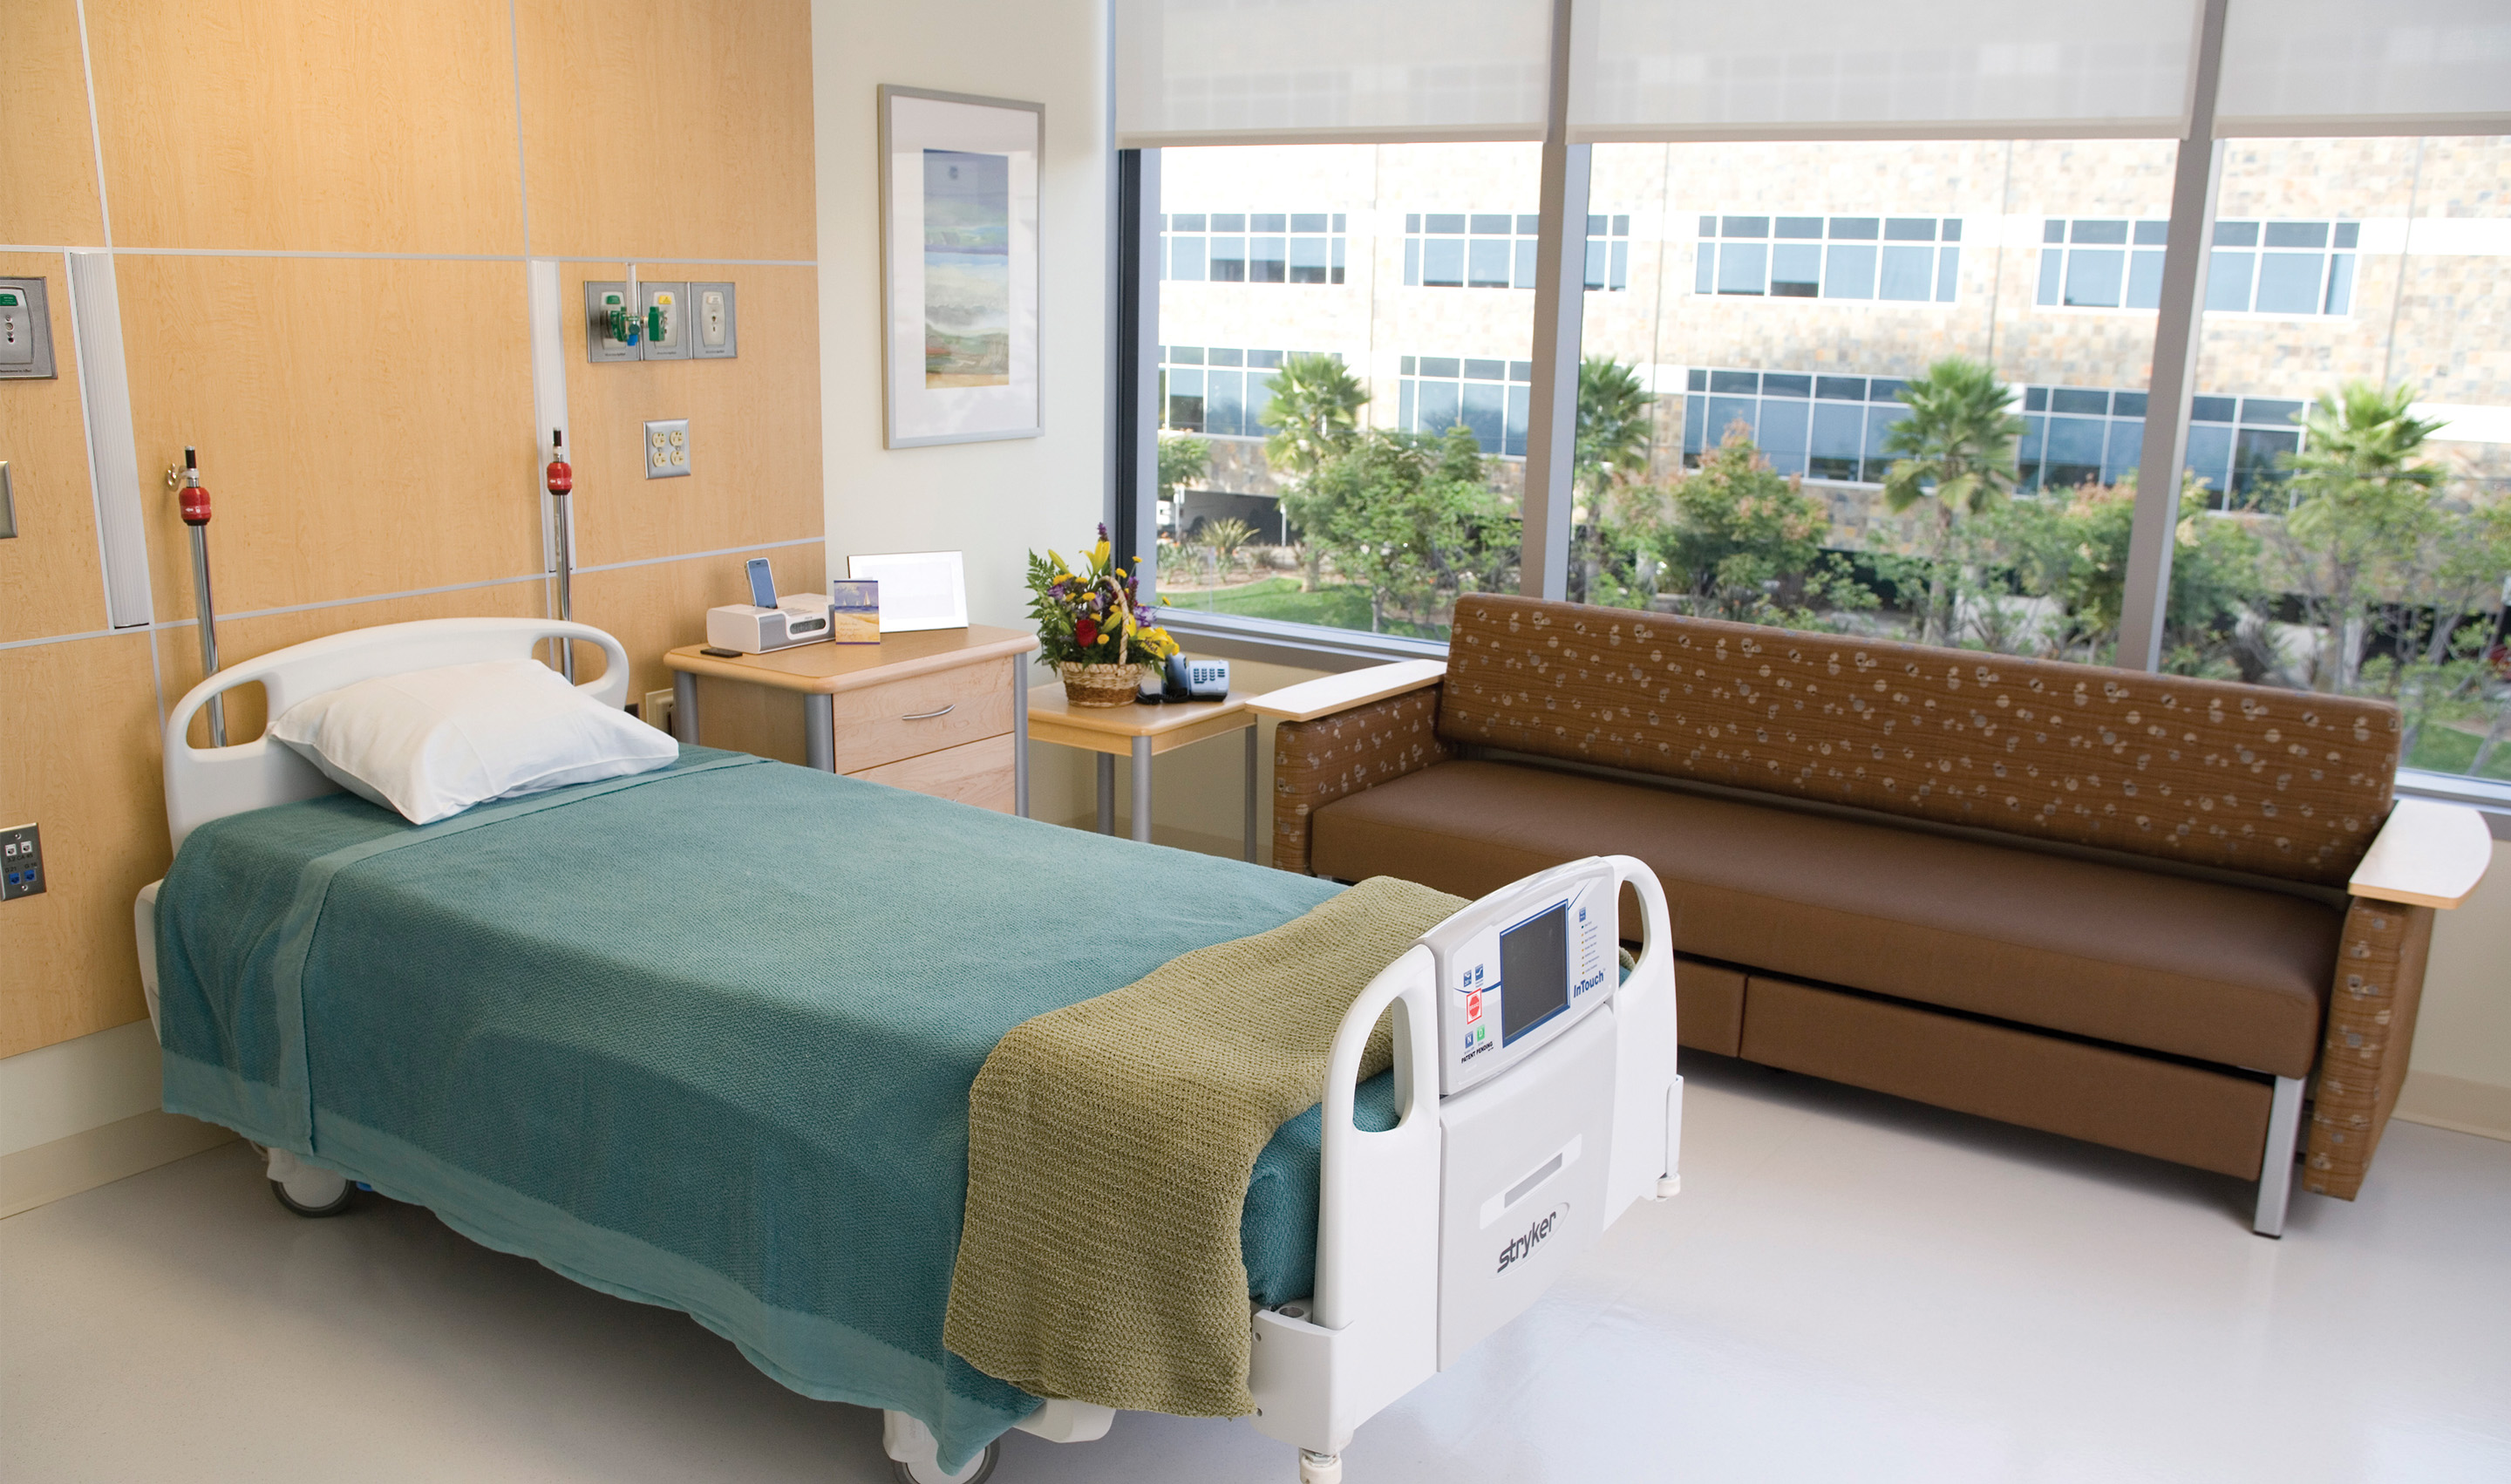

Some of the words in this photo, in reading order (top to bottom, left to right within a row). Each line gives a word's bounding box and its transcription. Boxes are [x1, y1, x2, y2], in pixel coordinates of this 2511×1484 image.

[1574, 971, 1604, 998] InTouch
[1461, 1051, 1475, 1064] PATENT
[1476, 1041, 1494, 1055] PENDING
[1497, 1211, 1556, 1273] stryker
